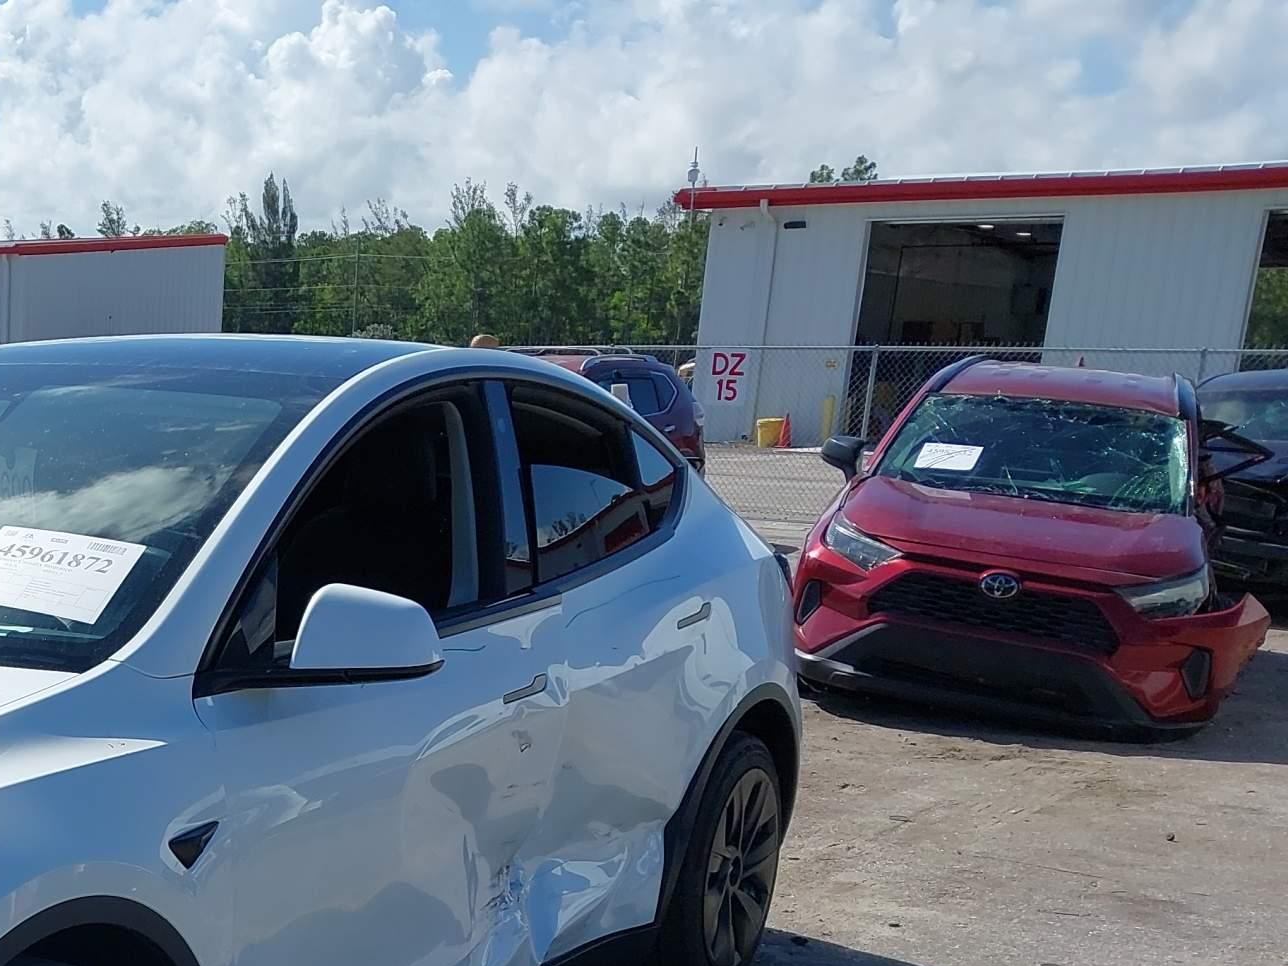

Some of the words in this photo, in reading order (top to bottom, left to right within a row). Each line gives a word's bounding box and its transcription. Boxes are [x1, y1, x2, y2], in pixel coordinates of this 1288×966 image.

[711, 352, 747, 377] DZ
[716, 378, 738, 401] 15
[0, 543, 114, 574] 45961872
